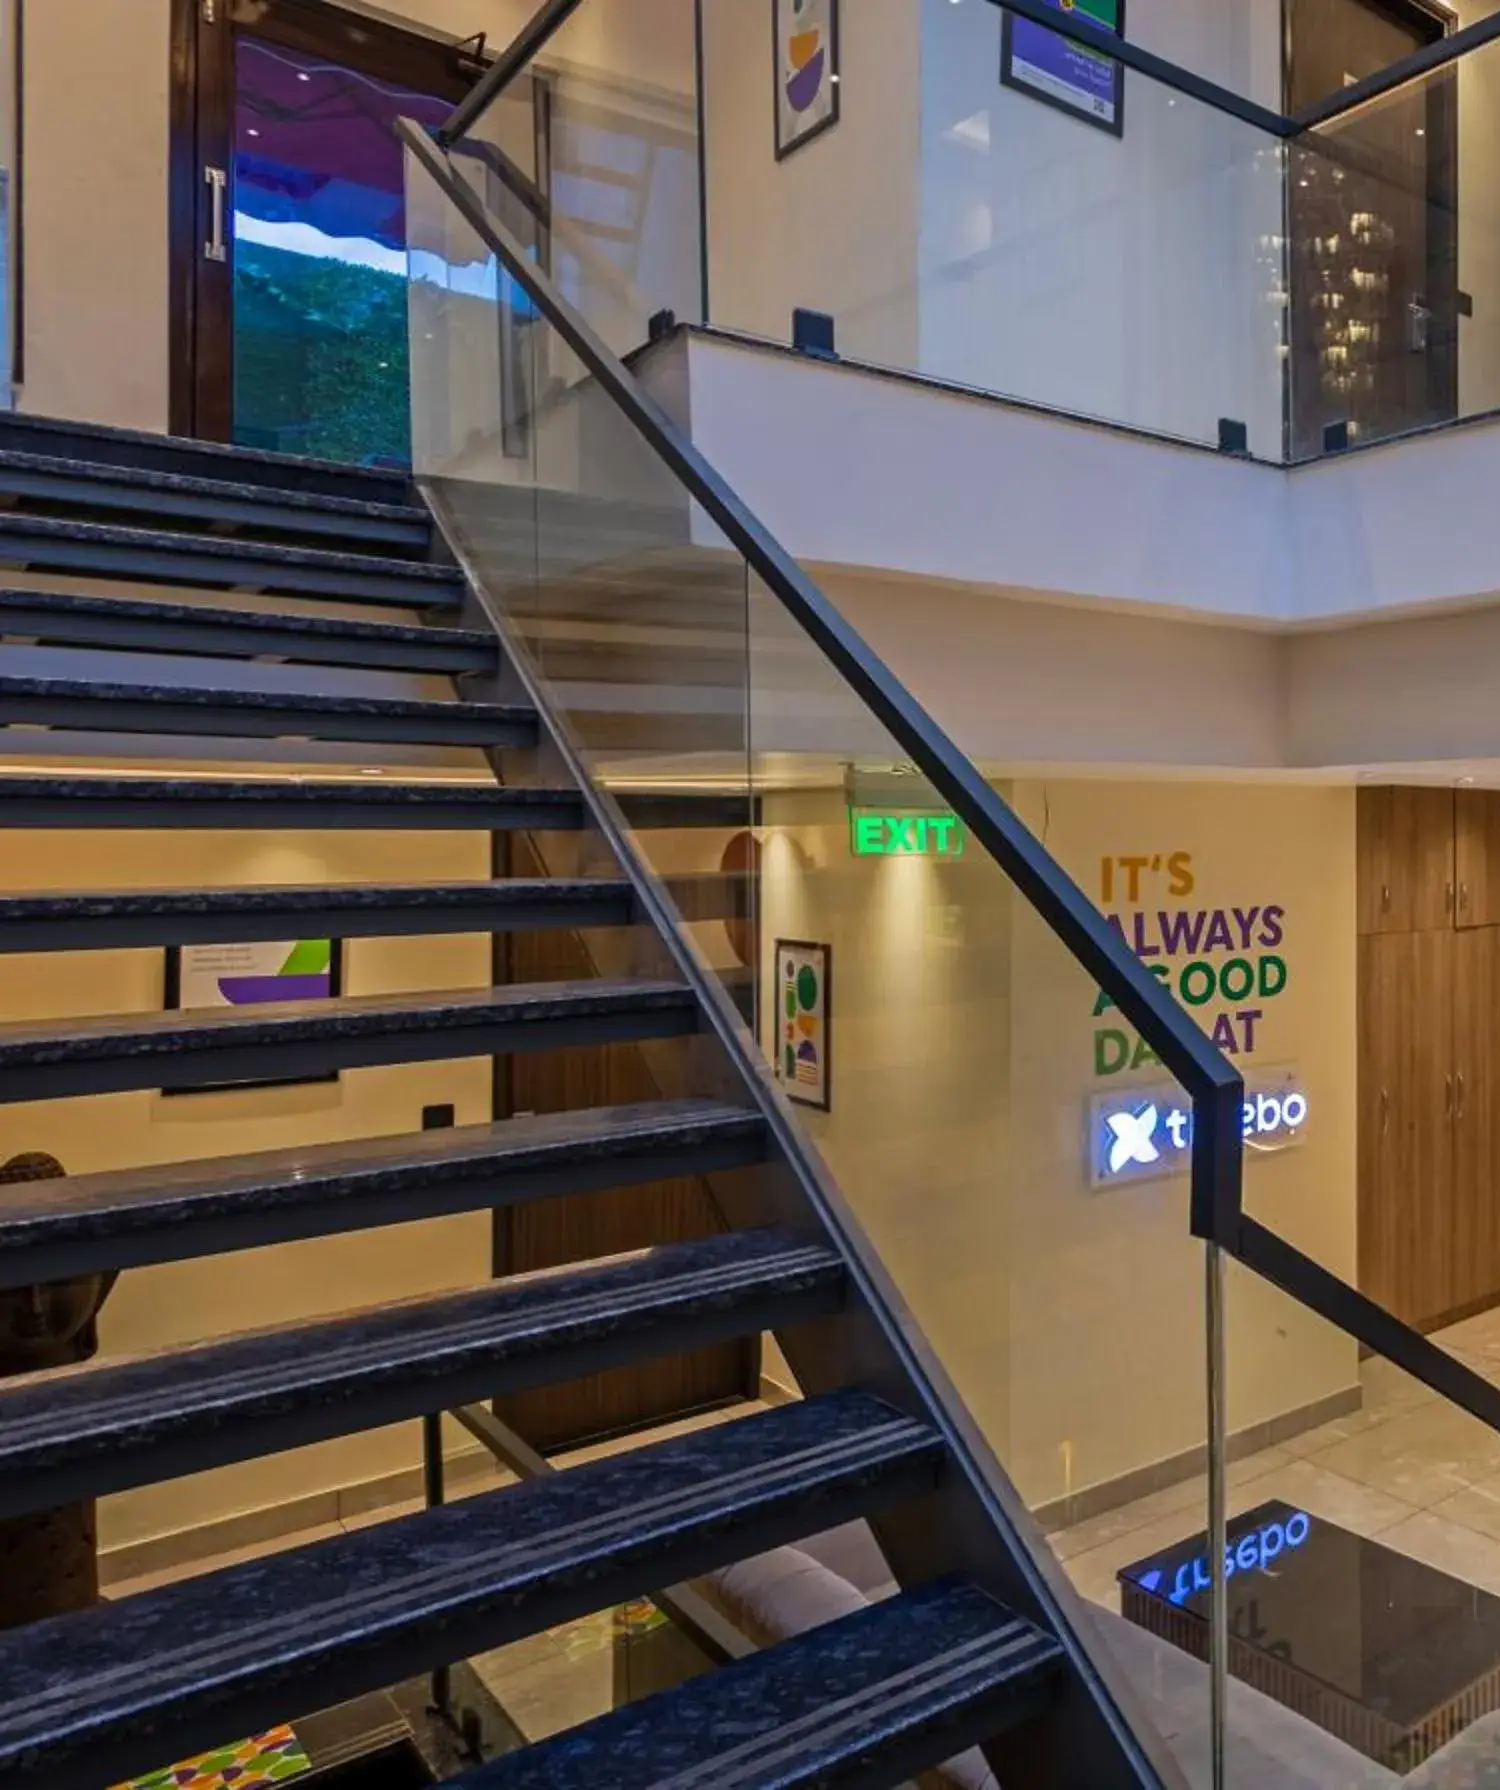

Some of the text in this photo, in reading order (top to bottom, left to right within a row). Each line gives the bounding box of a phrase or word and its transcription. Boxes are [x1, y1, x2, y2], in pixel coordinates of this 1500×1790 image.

[857, 816, 956, 853] EXIT
[1101, 851, 1194, 903] IT'S
[1211, 1009, 1263, 1054] AT
[1165, 1092, 1307, 1149] tebo
